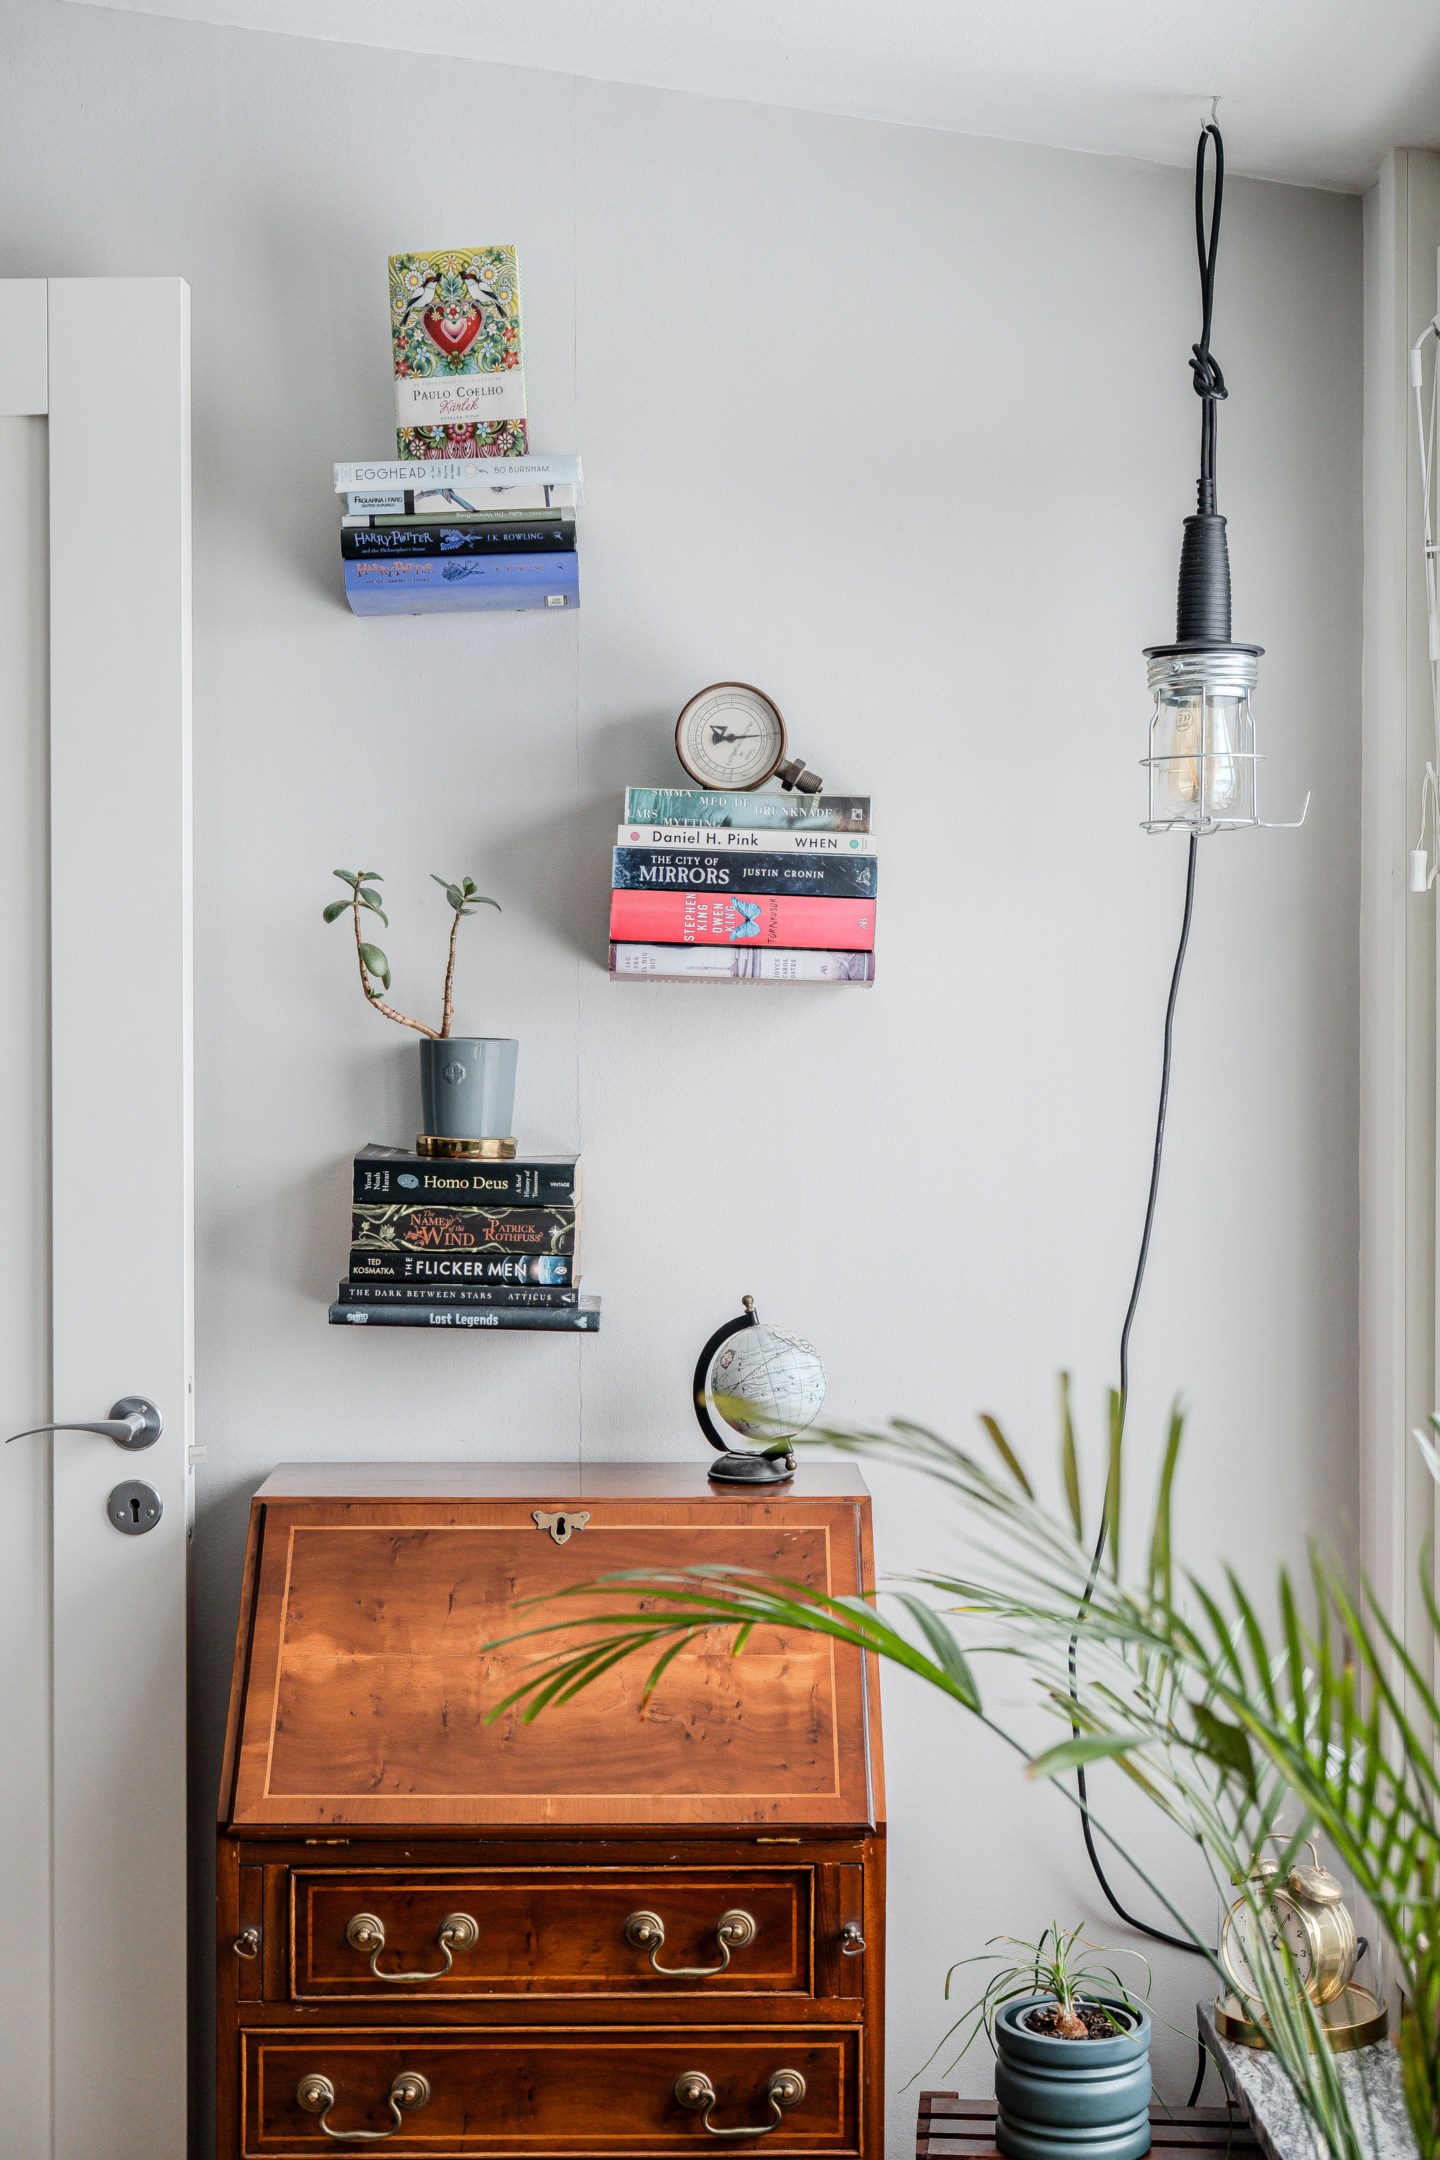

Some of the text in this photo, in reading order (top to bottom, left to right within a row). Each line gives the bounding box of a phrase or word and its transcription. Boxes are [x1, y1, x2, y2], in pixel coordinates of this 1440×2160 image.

[413, 386, 504, 400] PAULO COELHO
[440, 397, 479, 414] Kärlek
[355, 467, 426, 480] EGGHEAD
[494, 466, 506, 474] BO
[509, 465, 549, 473] BURNHAM
[354, 531, 433, 547] HARRY POTTER
[356, 561, 436, 577] HARRY POTTER
[651, 789, 692, 798] SIMMA
[700, 796, 750, 807] MED DE
[628, 808, 657, 819] LARS
[755, 806, 833, 818] DRUNKNADE
[663, 818, 720, 827] MYTTING
[652, 830, 837, 848] Daniel H. Pink WHEN
[650, 855, 719, 866] THE CITY OF
[640, 866, 730, 884] MIRRORS
[743, 868, 824, 879] JUSTIN CRONIN
[684, 893, 696, 942] STEPHEN
[697, 904, 708, 931] KING
[712, 903, 724, 934] OWEN
[724, 905, 736, 932] KING
[364, 1172, 372, 1190] Yuval
[424, 1176, 508, 1190] Homo Deus
[410, 1214, 447, 1226] NAME
[488, 1218, 535, 1233] PATRICK
[421, 1226, 475, 1246] WIND
[483, 1228, 543, 1242] ROTHFUSS
[367, 1258, 382, 1266] TED
[405, 1257, 526, 1277] THE FLICKER MEN
[353, 1267, 395, 1275] KOSMATKA
[375, 1289, 402, 1297] DARK
[407, 1290, 456, 1298] BETWEEN
[508, 1293, 552, 1301] ATTICUS
[430, 1313, 498, 1327] Lost Legends
[1270, 1905, 1278, 1913] 12
[1297, 1930, 1303, 1938] 2
[1301, 1949, 1306, 1957] 3
[1284, 1978, 1289, 1986] 5
